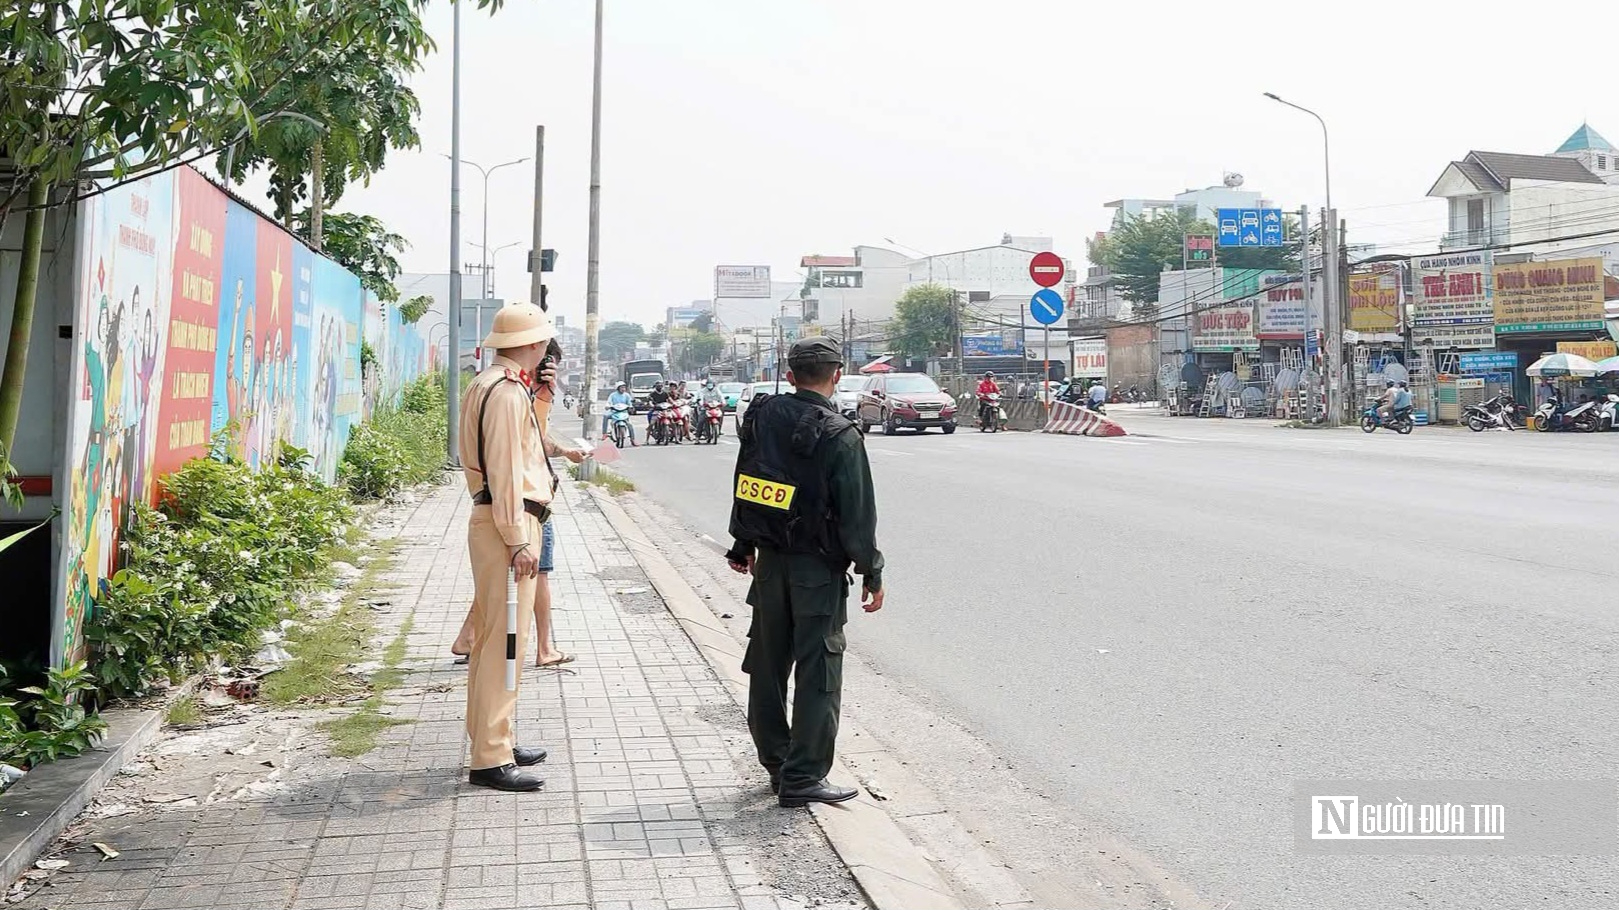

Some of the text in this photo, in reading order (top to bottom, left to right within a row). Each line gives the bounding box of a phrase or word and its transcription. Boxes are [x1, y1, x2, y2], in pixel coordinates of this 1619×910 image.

[1448, 256, 1466, 266] NHÔM
[1466, 254, 1482, 265] KÍNH
[1528, 268, 1564, 288] QUANG
[1288, 286, 1314, 301] PHT
[1371, 292, 1396, 310] LỘC
[740, 480, 786, 503] CSCĐ
